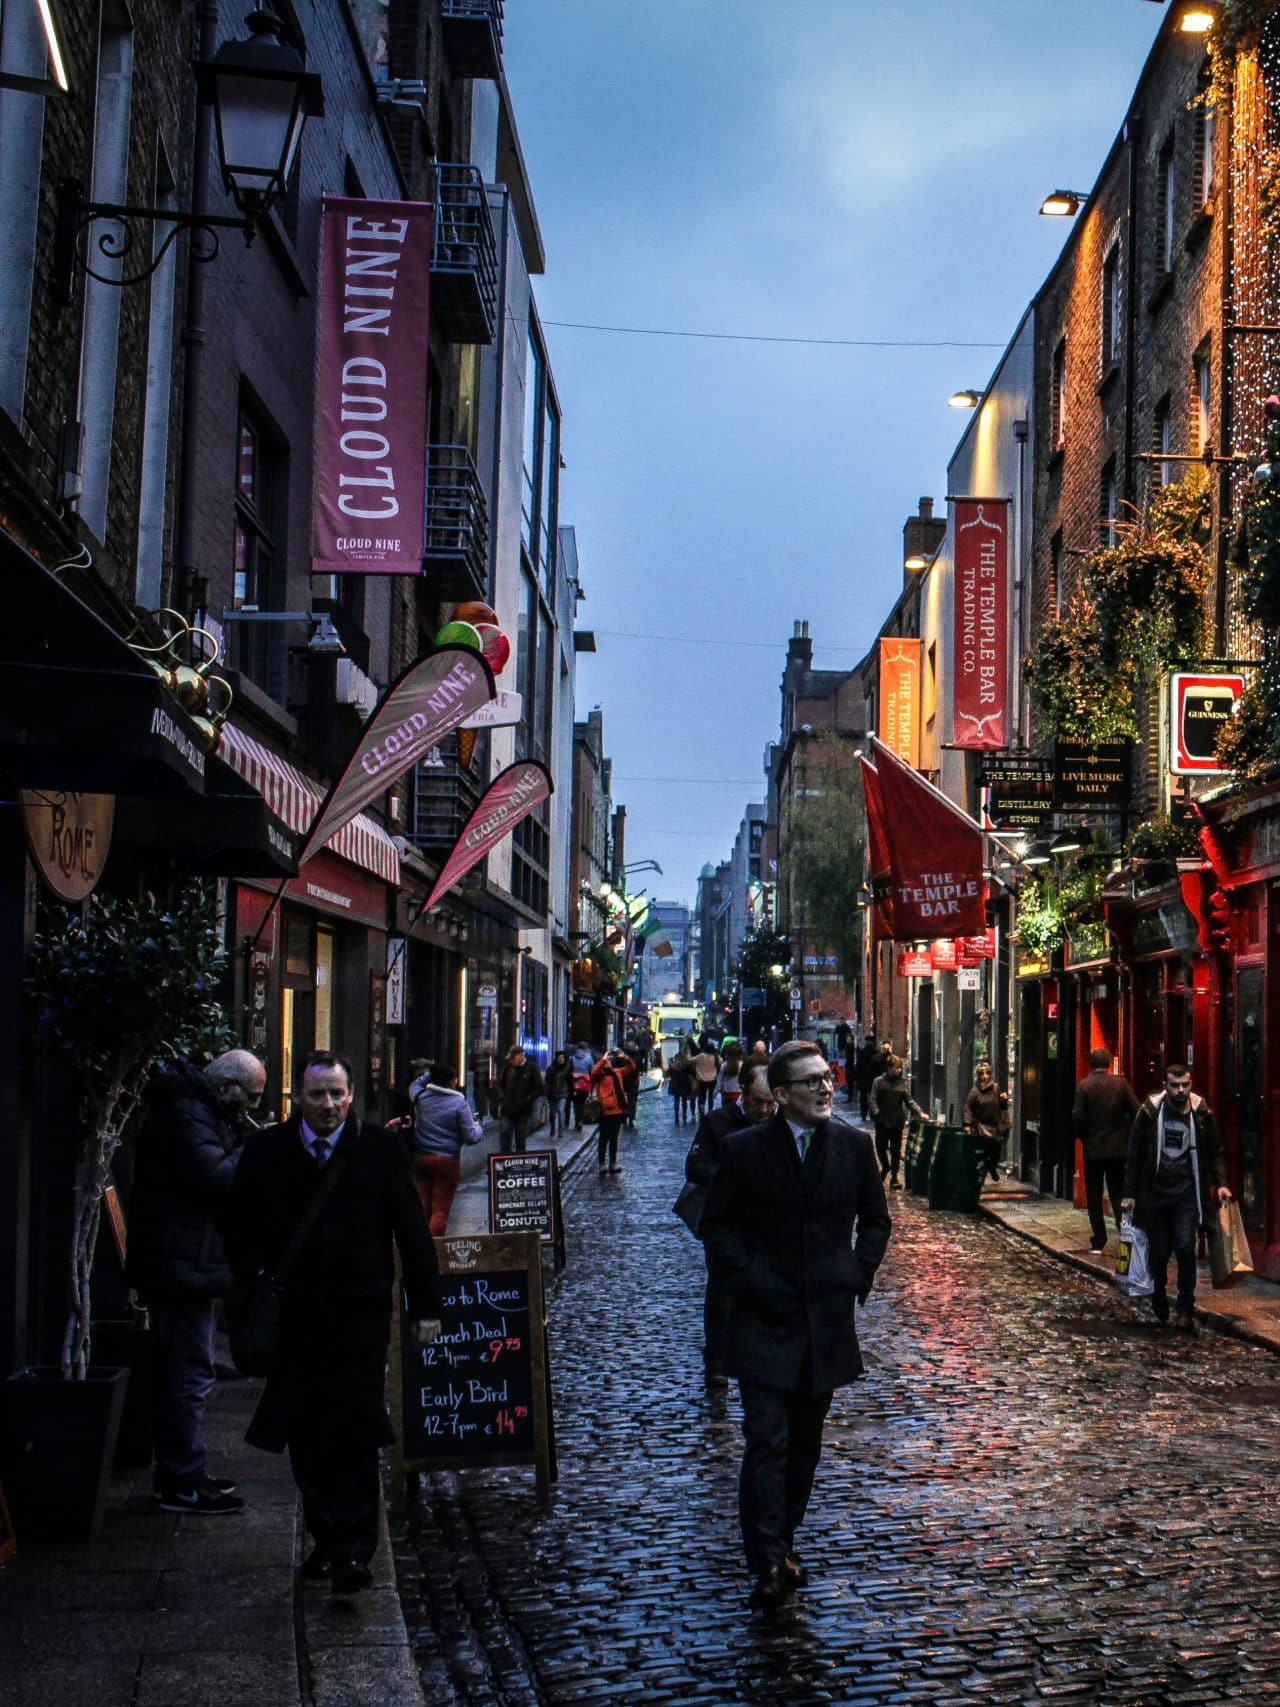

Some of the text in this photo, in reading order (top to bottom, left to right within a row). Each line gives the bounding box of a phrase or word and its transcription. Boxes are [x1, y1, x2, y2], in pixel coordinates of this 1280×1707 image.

[338, 216, 409, 519] CLOUD NINE
[336, 537, 401, 552] CLOUD NINE
[963, 567, 976, 676] TRADING CO.
[979, 540, 996, 705] THE TEMPLE BAR
[361, 712, 428, 776] CLOUD
[427, 661, 477, 715] NINE
[886, 691, 897, 750] TRADING
[898, 670, 912, 764] THE TEMPLE
[1188, 711, 1229, 720] GUINNESS
[985, 771, 1056, 781] THE TEMPLE BA
[1062, 772, 1124, 782] LIVE MUSIC
[1076, 784, 1110, 793] DAILY
[465, 770, 540, 849] CLOUD NINE
[997, 800, 1052, 809] DISTILLERY
[1009, 815, 1040, 823] STORE
[49, 805, 96, 882] ROME
[920, 872, 954, 885] THE
[898, 881, 979, 903] TEMPLE
[920, 900, 961, 918] BAR
[497, 1176, 547, 1189] COFFEE
[500, 1215, 548, 1228] DONUTS
[444, 1240, 482, 1252] TEELING
[461, 1285, 474, 1305] to
[472, 1279, 526, 1311] Rome
[430, 1316, 508, 1345] unch Deal
[420, 1379, 509, 1410] Early Bird
[424, 1413, 478, 1440] 12-7pm
